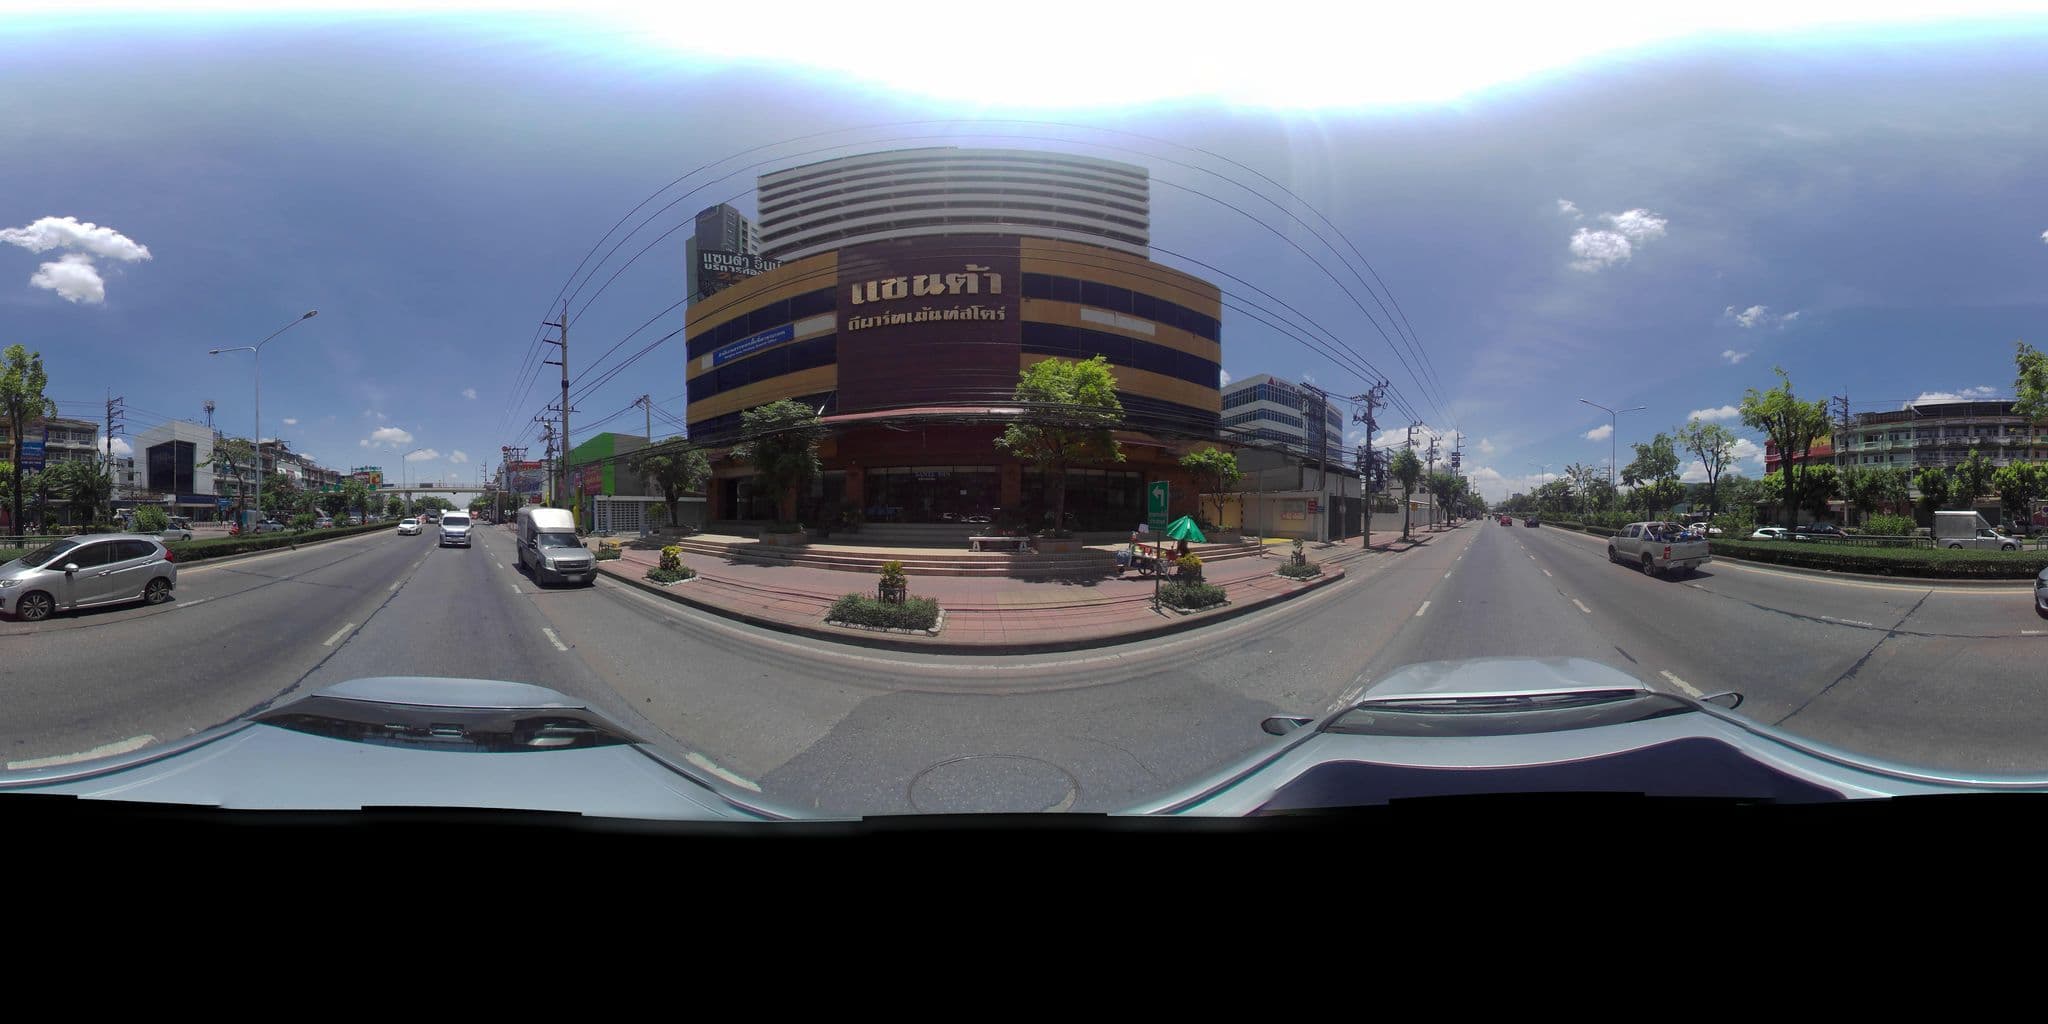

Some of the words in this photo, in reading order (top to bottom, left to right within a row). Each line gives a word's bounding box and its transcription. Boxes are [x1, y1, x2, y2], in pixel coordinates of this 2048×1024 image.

[703, 251, 750, 269] แซนต้า
[851, 263, 1002, 305] แซนต้า
